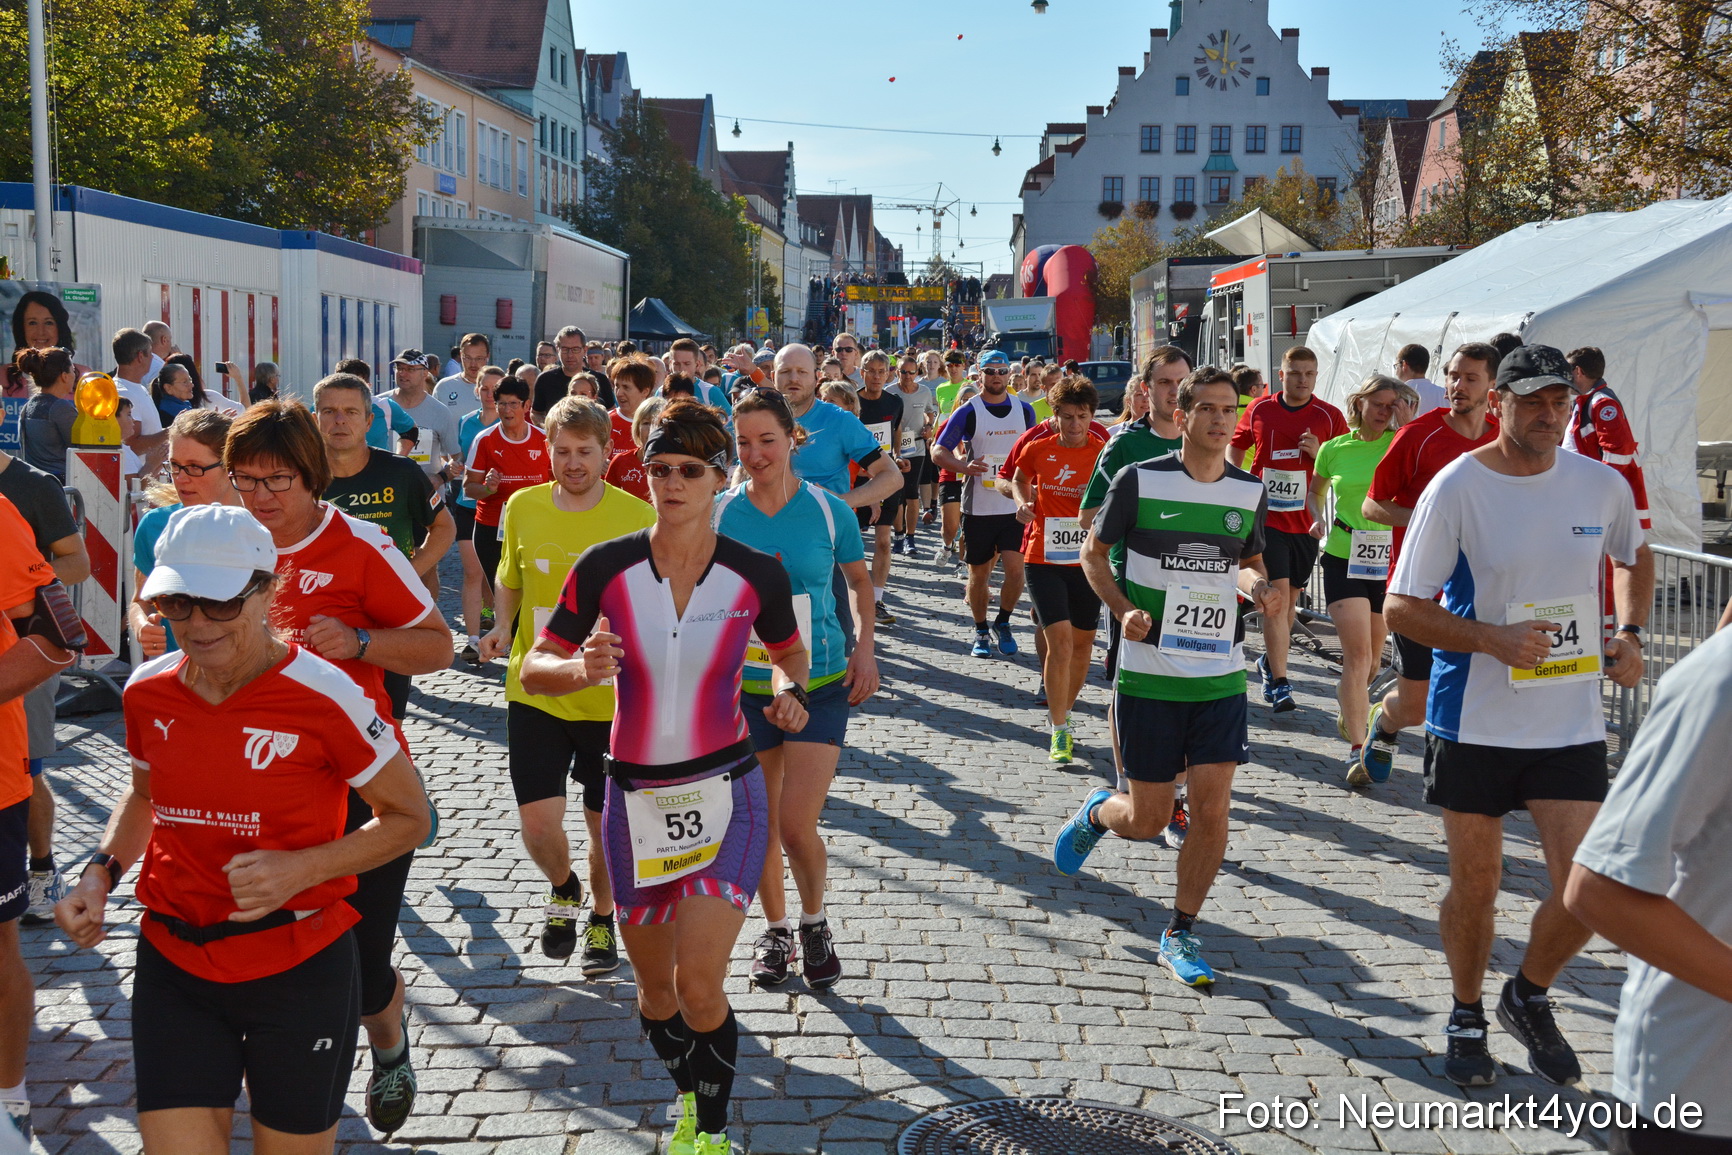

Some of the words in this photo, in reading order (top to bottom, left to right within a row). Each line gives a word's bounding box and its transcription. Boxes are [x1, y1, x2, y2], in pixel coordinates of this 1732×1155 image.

[878, 288, 912, 298] START
[1268, 480, 1300, 495] 2447
[349, 486, 395, 506] 2018
[1052, 530, 1088, 545] 3048
[1356, 543, 1391, 559] 2579
[1165, 556, 1228, 572] MAGNERS
[1189, 591, 1220, 602] BOCK
[1174, 604, 1226, 629] 2120
[1535, 603, 1575, 618] BOCK
[1176, 637, 1217, 652] Wolfgang
[758, 652, 770, 662] Ju
[1550, 650, 1576, 658] Neumarkt
[1535, 661, 1578, 676] Gerhard
[656, 791, 703, 806] BOCK
[205, 811, 213, 819] &
[217, 811, 260, 823] WALTER
[232, 828, 260, 837] Lauf
[665, 810, 703, 841] 53
[656, 846, 678, 854] PARTL
[679, 840, 703, 851] Neumarkt
[663, 852, 702, 872] Melanie
